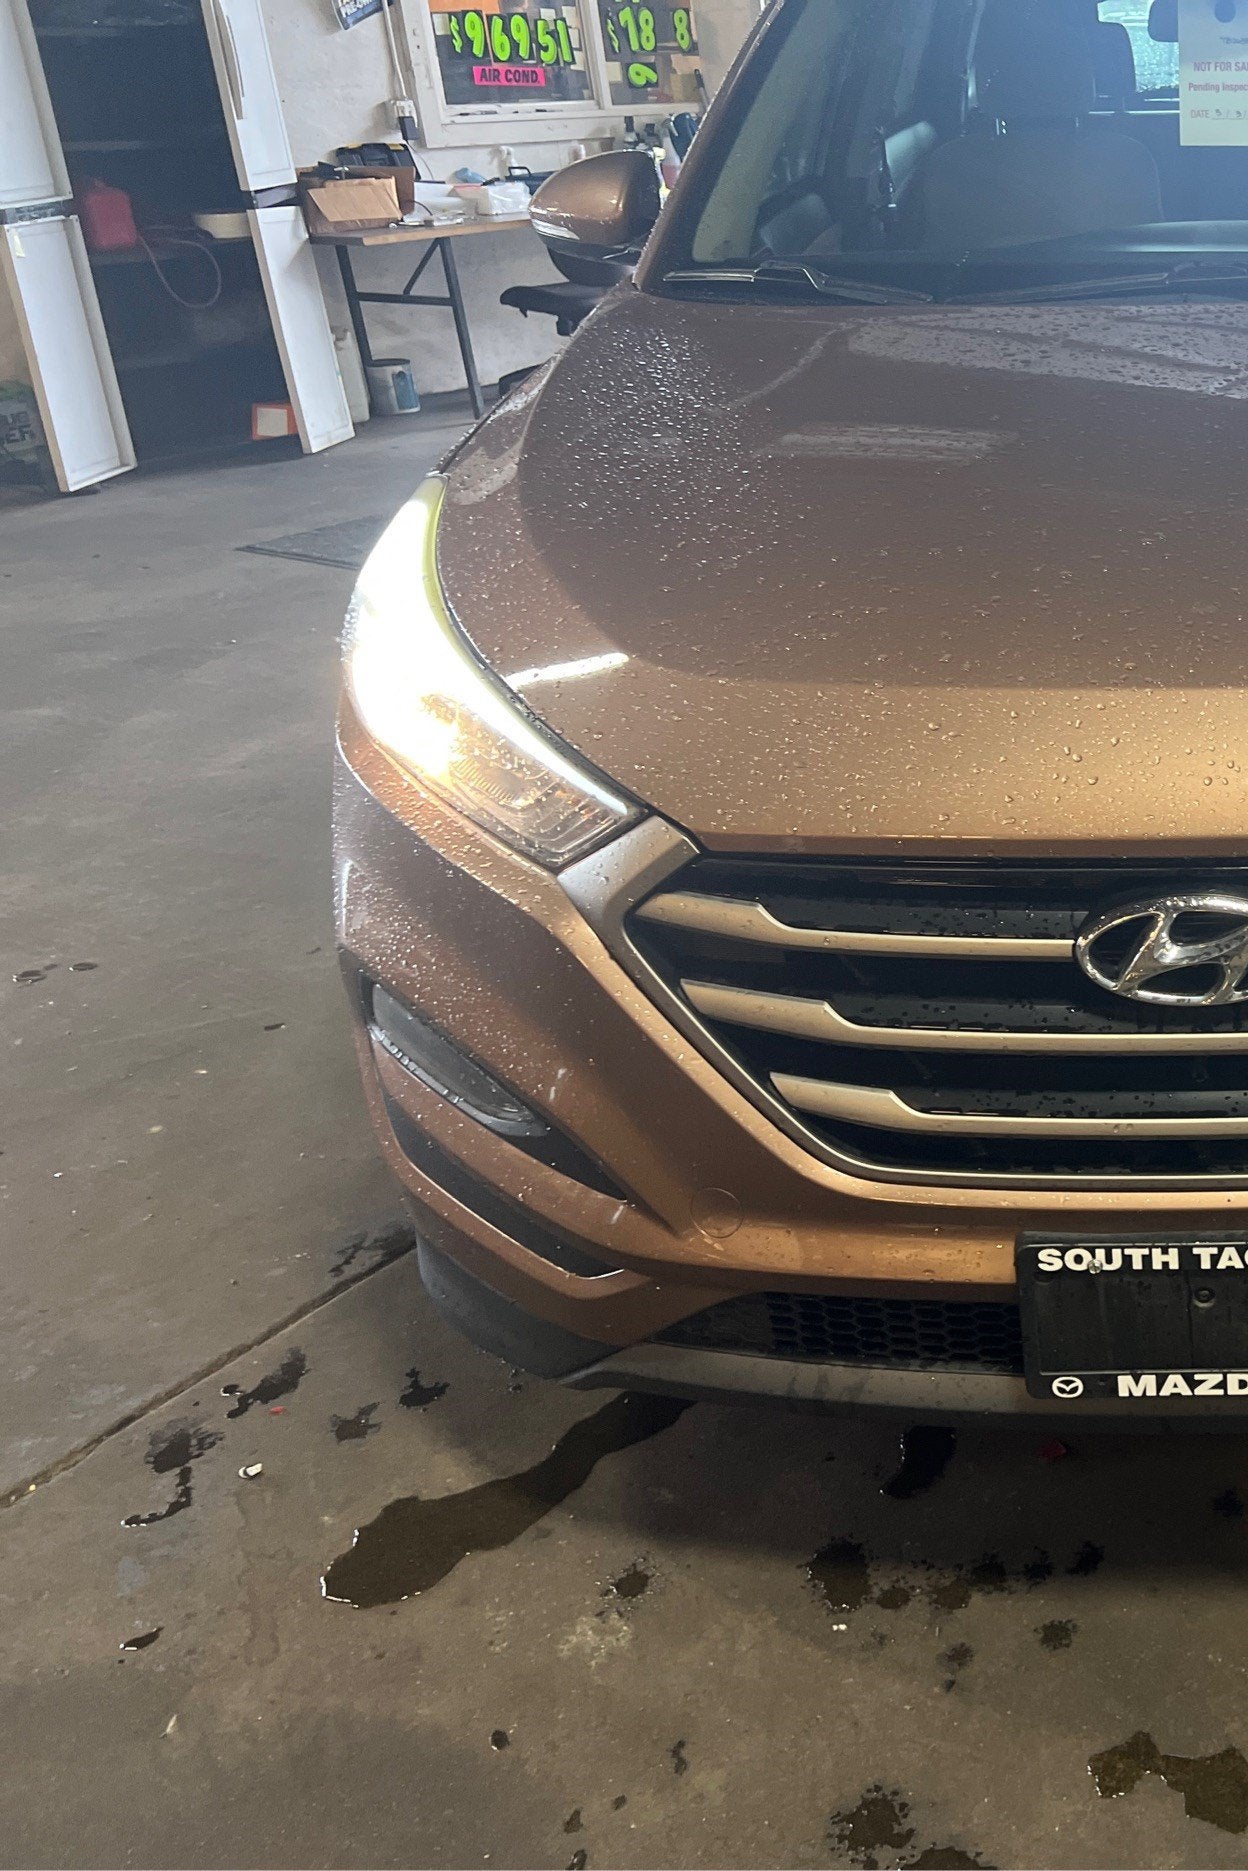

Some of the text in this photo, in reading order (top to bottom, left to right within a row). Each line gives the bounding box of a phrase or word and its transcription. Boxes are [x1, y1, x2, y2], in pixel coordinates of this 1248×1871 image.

[1193, 61, 1213, 72] NOT
[1214, 61, 1232, 72] FOR
[479, 67, 502, 83] AIR
[1188, 82, 1220, 93] Pending
[1190, 109, 1210, 119] DATE
[1037, 1247, 1180, 1273] SOUTH
